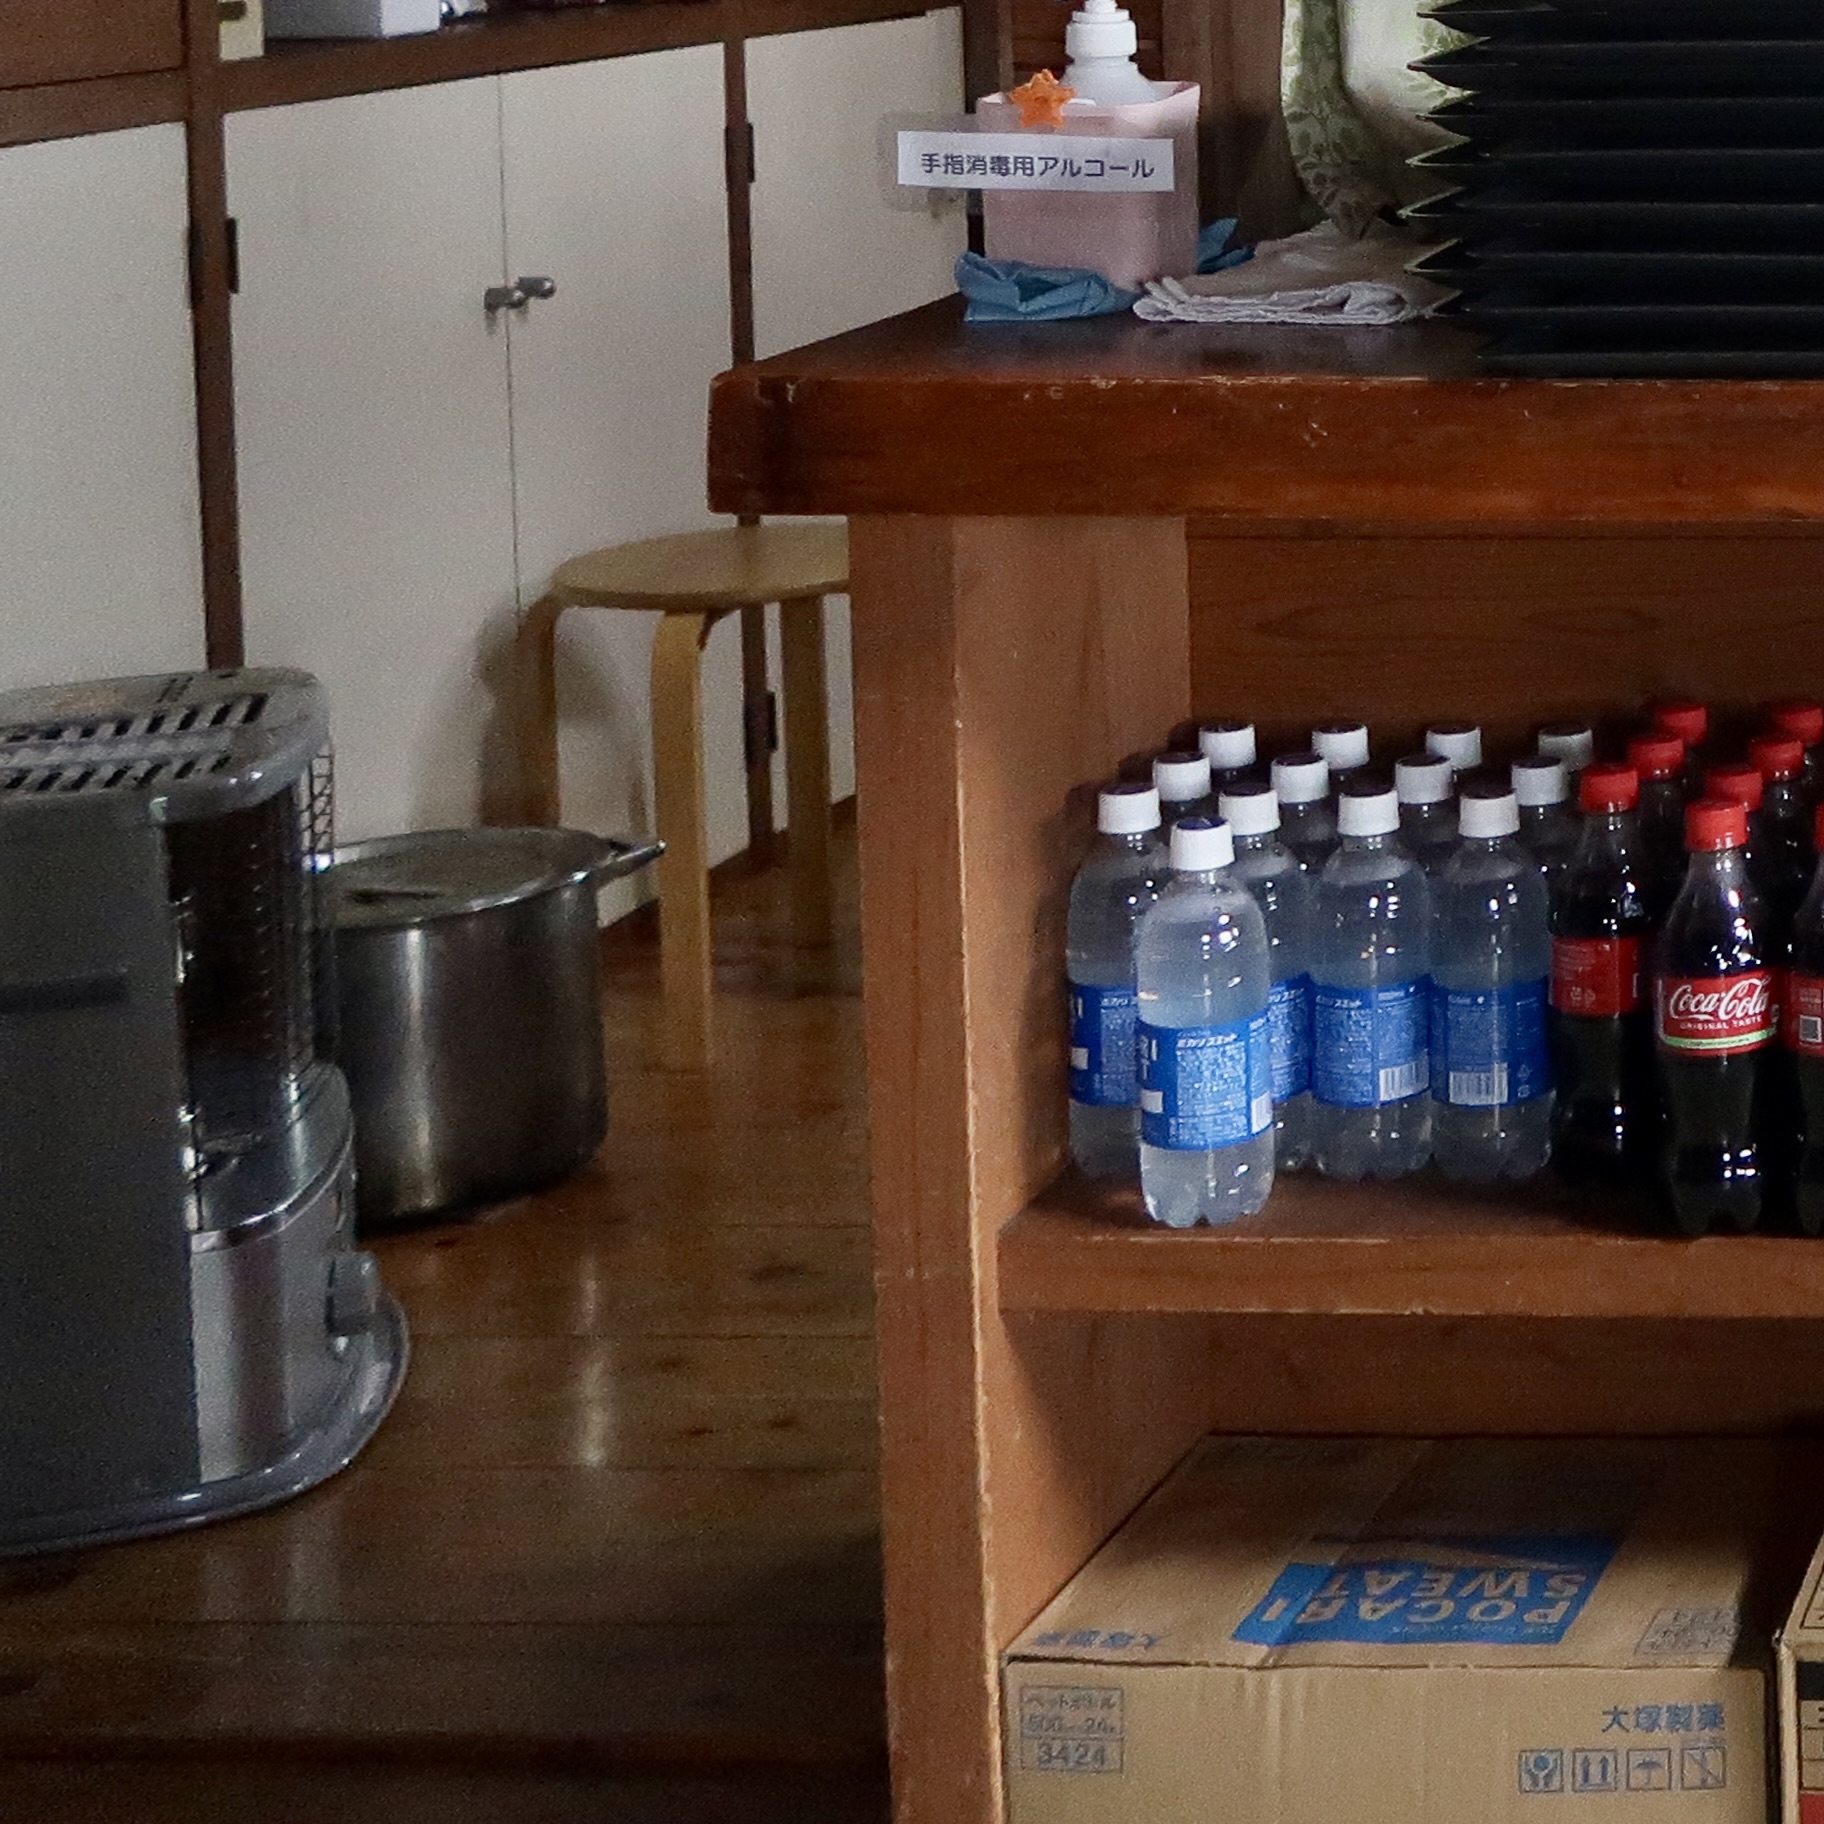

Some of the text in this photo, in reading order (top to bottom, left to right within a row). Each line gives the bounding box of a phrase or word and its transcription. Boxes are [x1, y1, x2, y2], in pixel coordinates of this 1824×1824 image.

[920, 152, 1155, 179] 手指消毒用アルコール
[1318, 1569, 1587, 1600] SWEAT
[1262, 1597, 1572, 1624] POCARI
[1602, 1702, 1726, 1731] 大塚製薬
